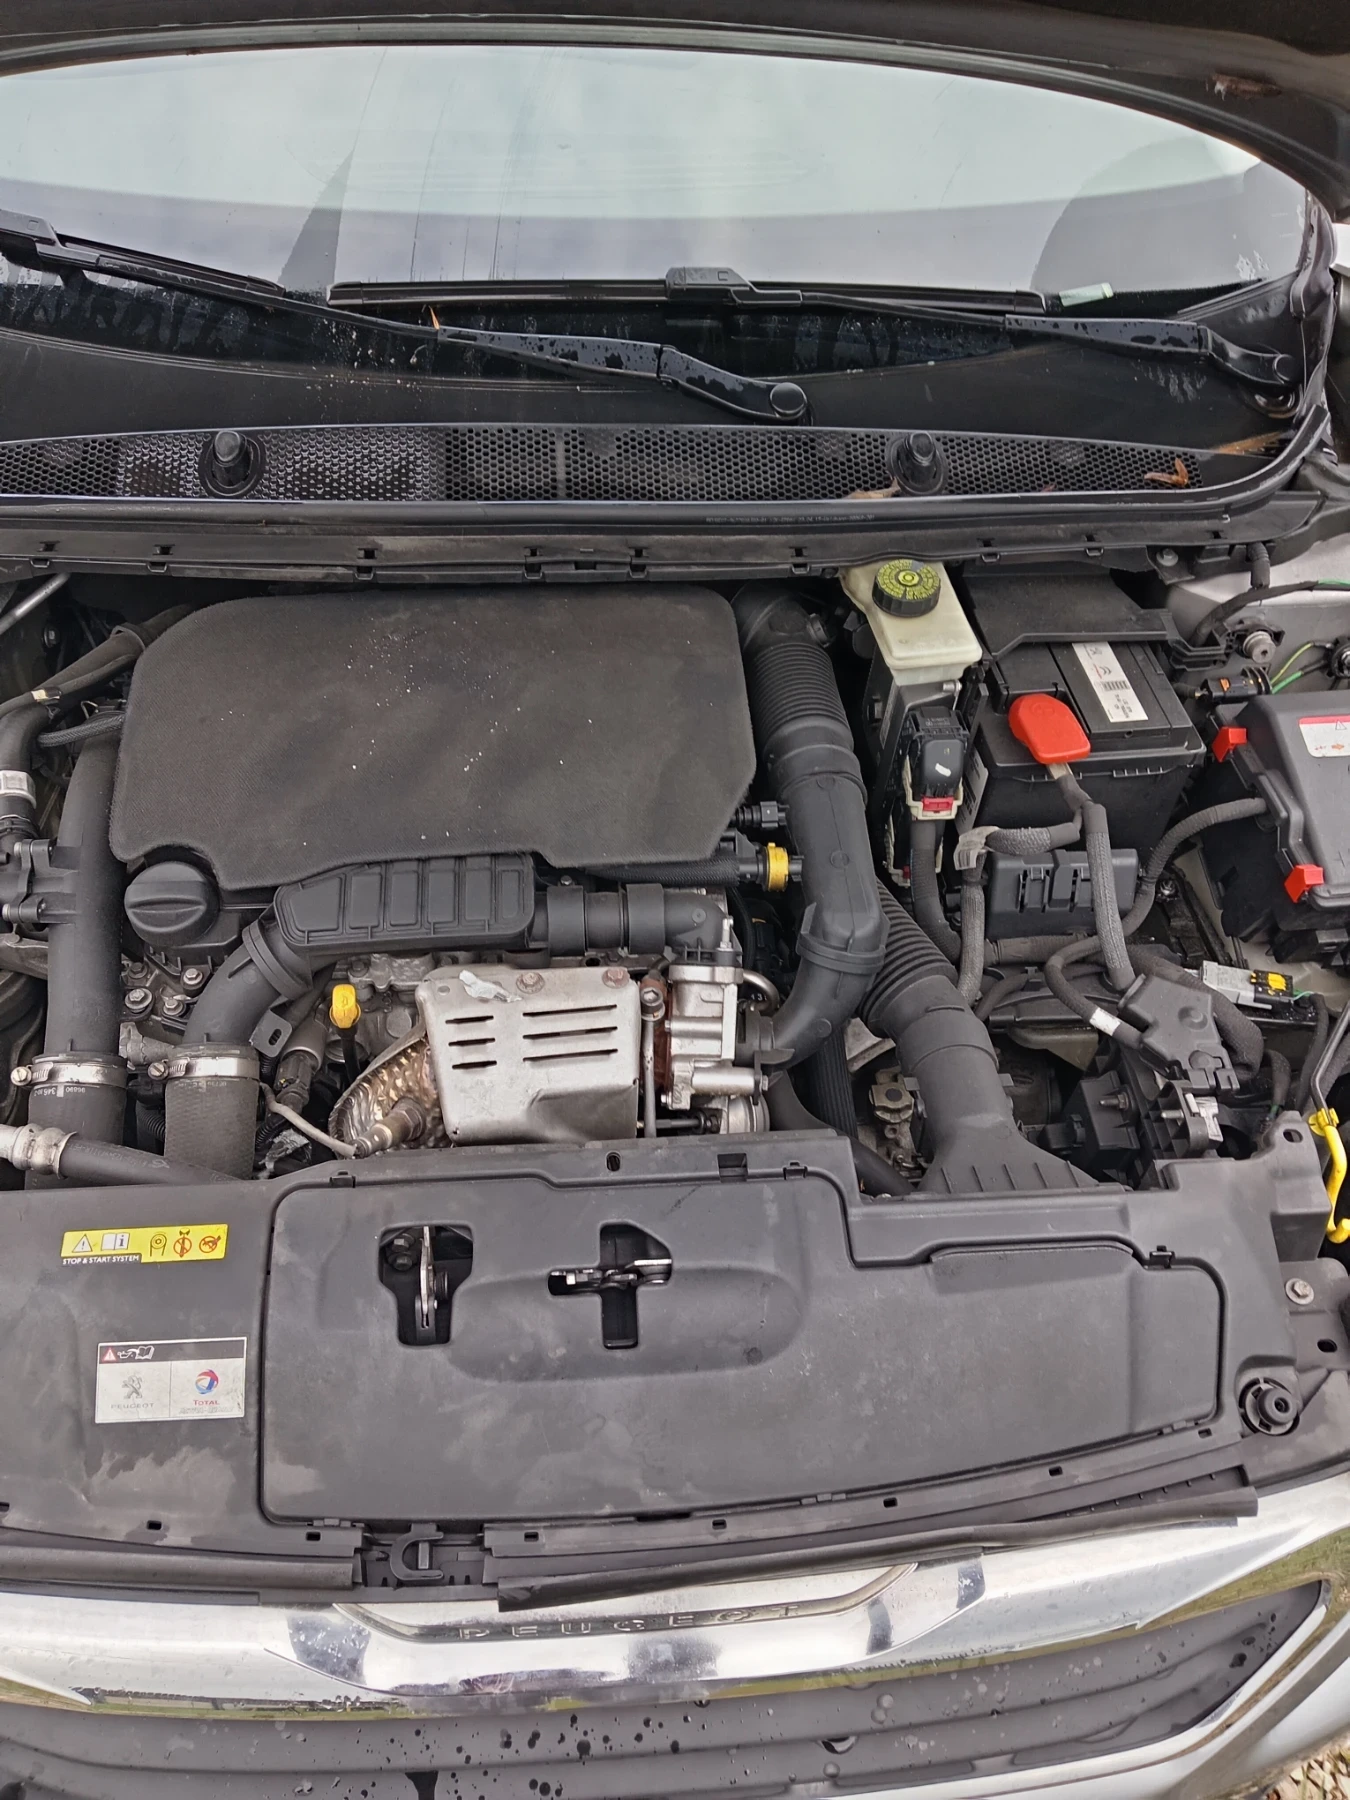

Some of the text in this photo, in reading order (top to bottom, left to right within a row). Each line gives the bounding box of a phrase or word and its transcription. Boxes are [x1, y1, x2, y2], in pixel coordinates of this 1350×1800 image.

[62, 1254, 140, 1265] STOP & START SYSTEM
[111, 1402, 154, 1410] PEUGEOT
[459, 1604, 802, 1641] PEUGEOT
